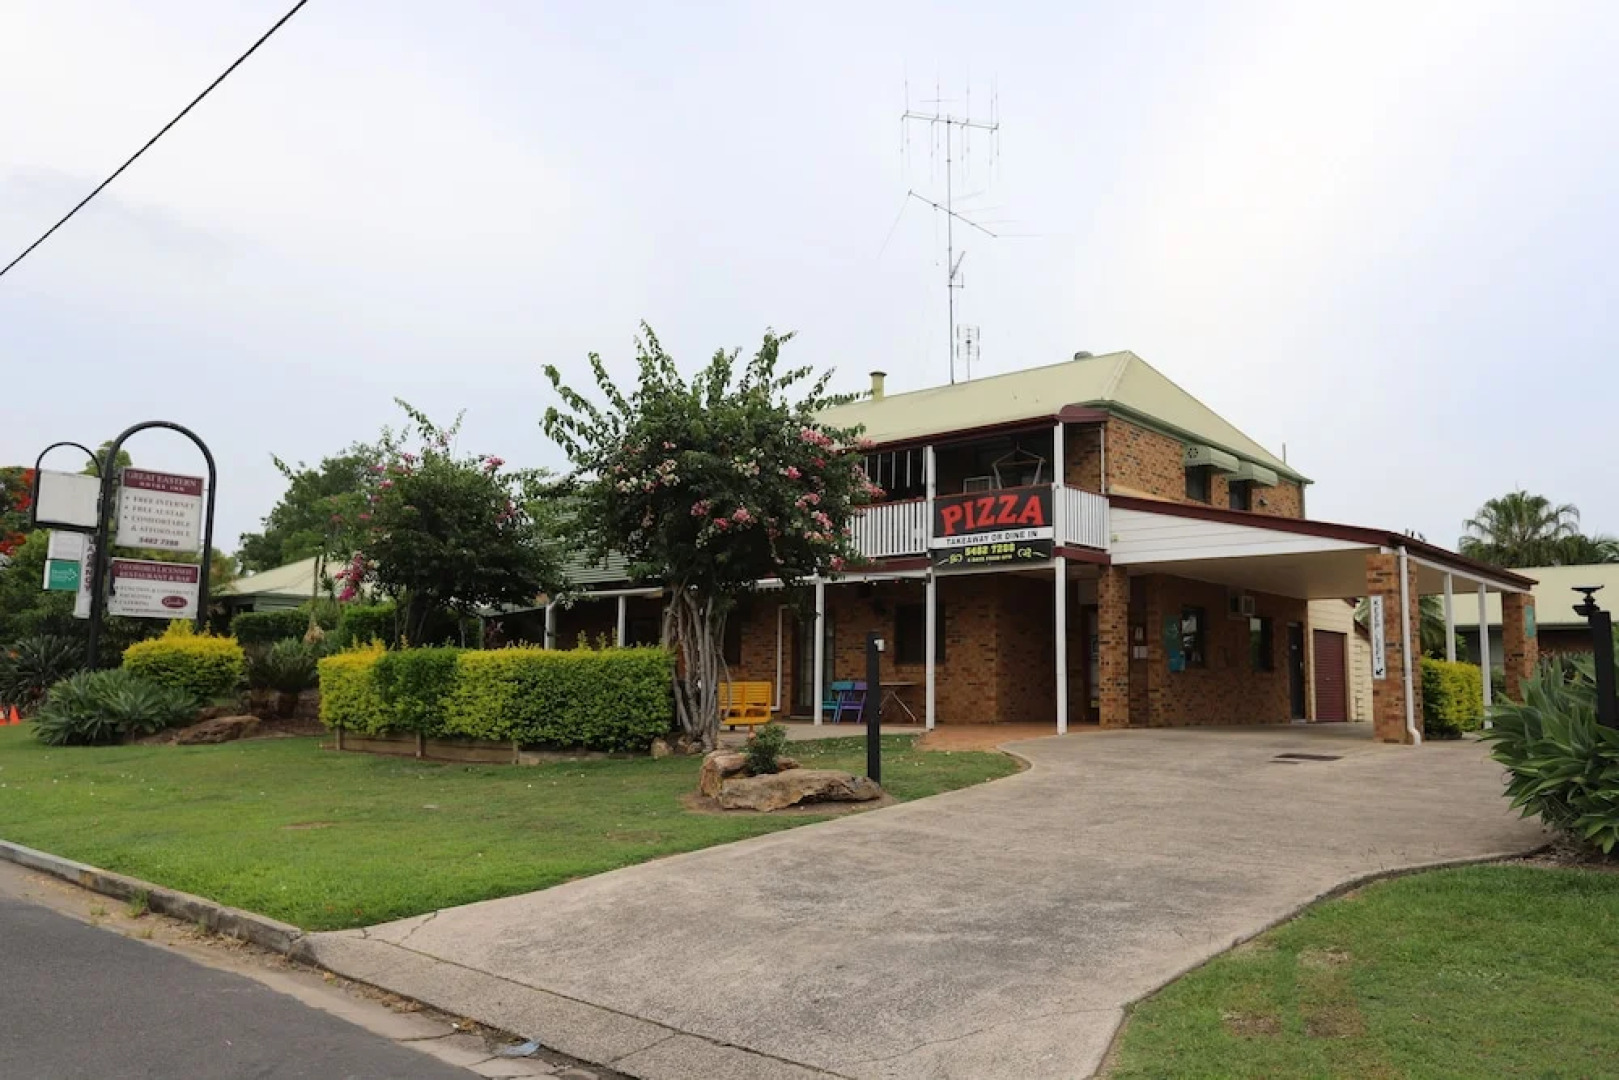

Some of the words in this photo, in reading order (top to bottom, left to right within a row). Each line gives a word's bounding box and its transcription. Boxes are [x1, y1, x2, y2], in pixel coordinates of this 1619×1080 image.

[941, 494, 1045, 536] PIZZA
[946, 536, 989, 546] TAKEAWAY
[991, 533, 1003, 541] OR
[1005, 531, 1026, 539] DINE
